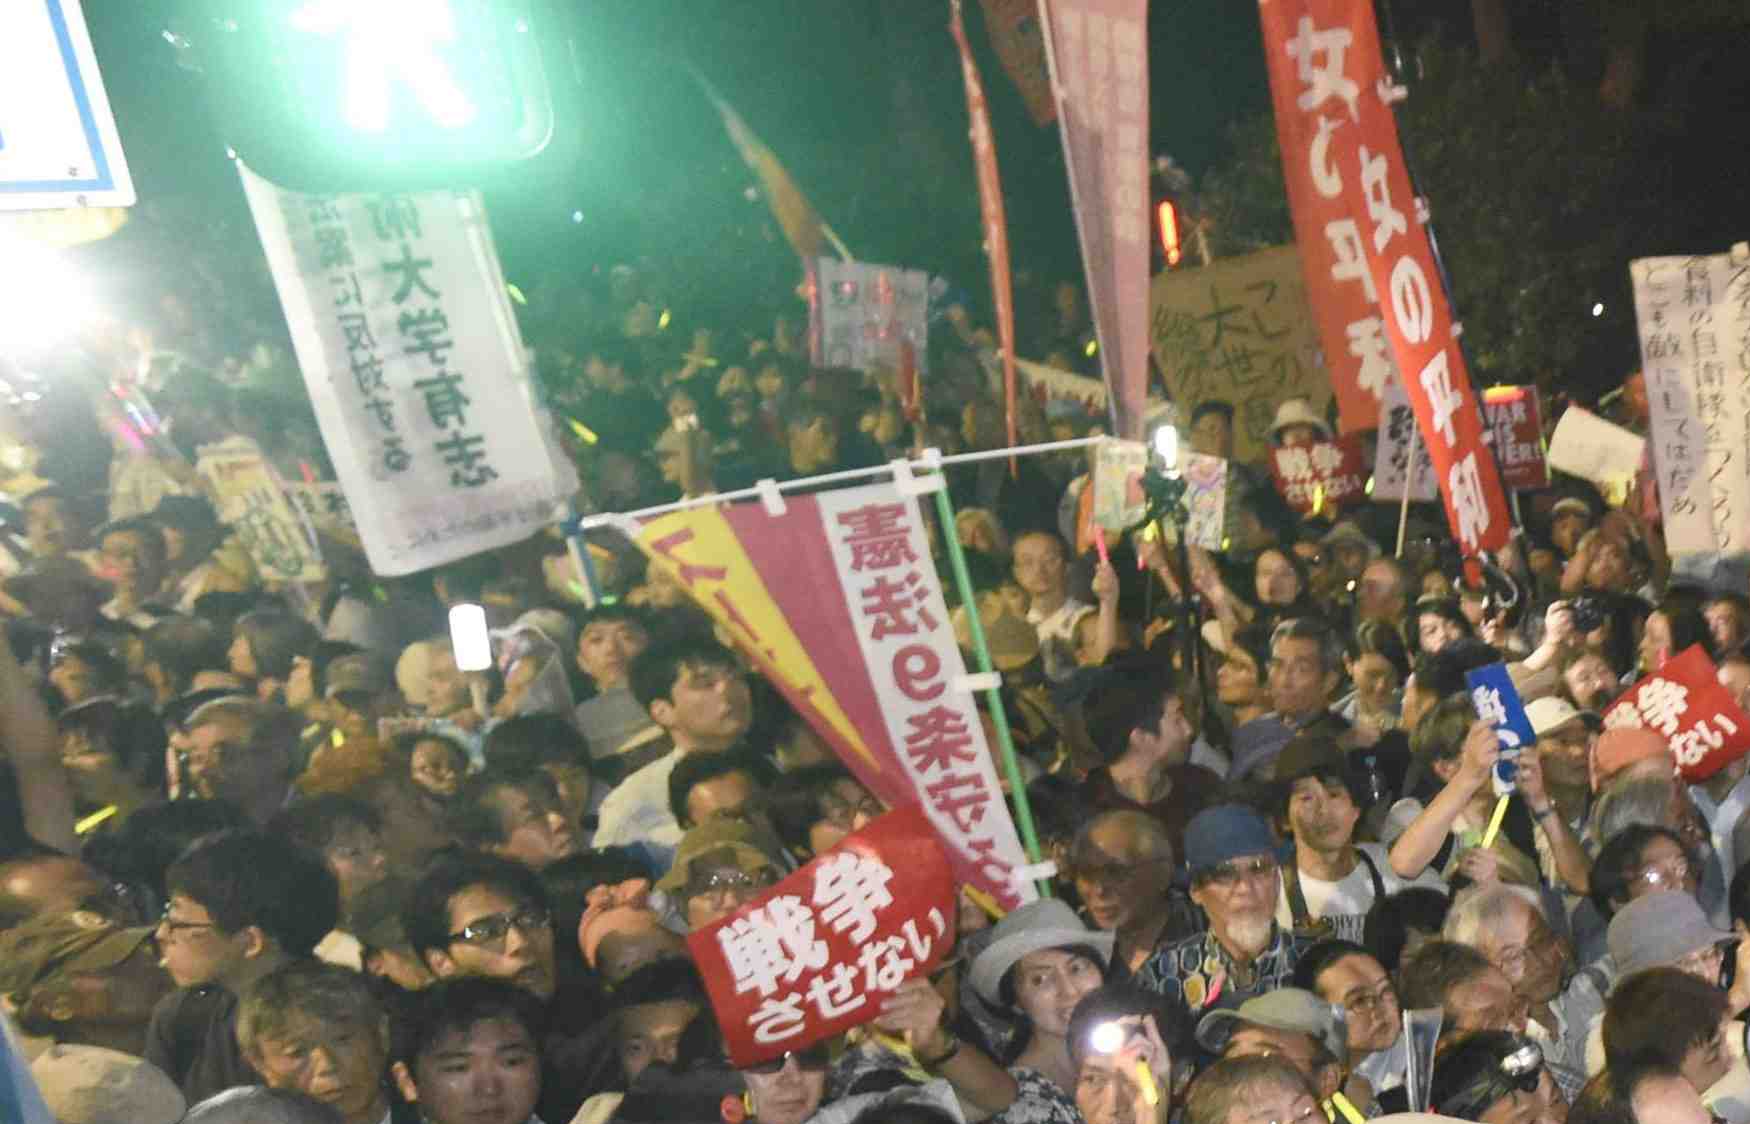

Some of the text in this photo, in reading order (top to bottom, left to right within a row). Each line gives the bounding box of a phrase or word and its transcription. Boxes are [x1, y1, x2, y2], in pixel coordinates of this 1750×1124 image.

[717, 852, 895, 996] 戦争
[747, 907, 947, 1044] させない
